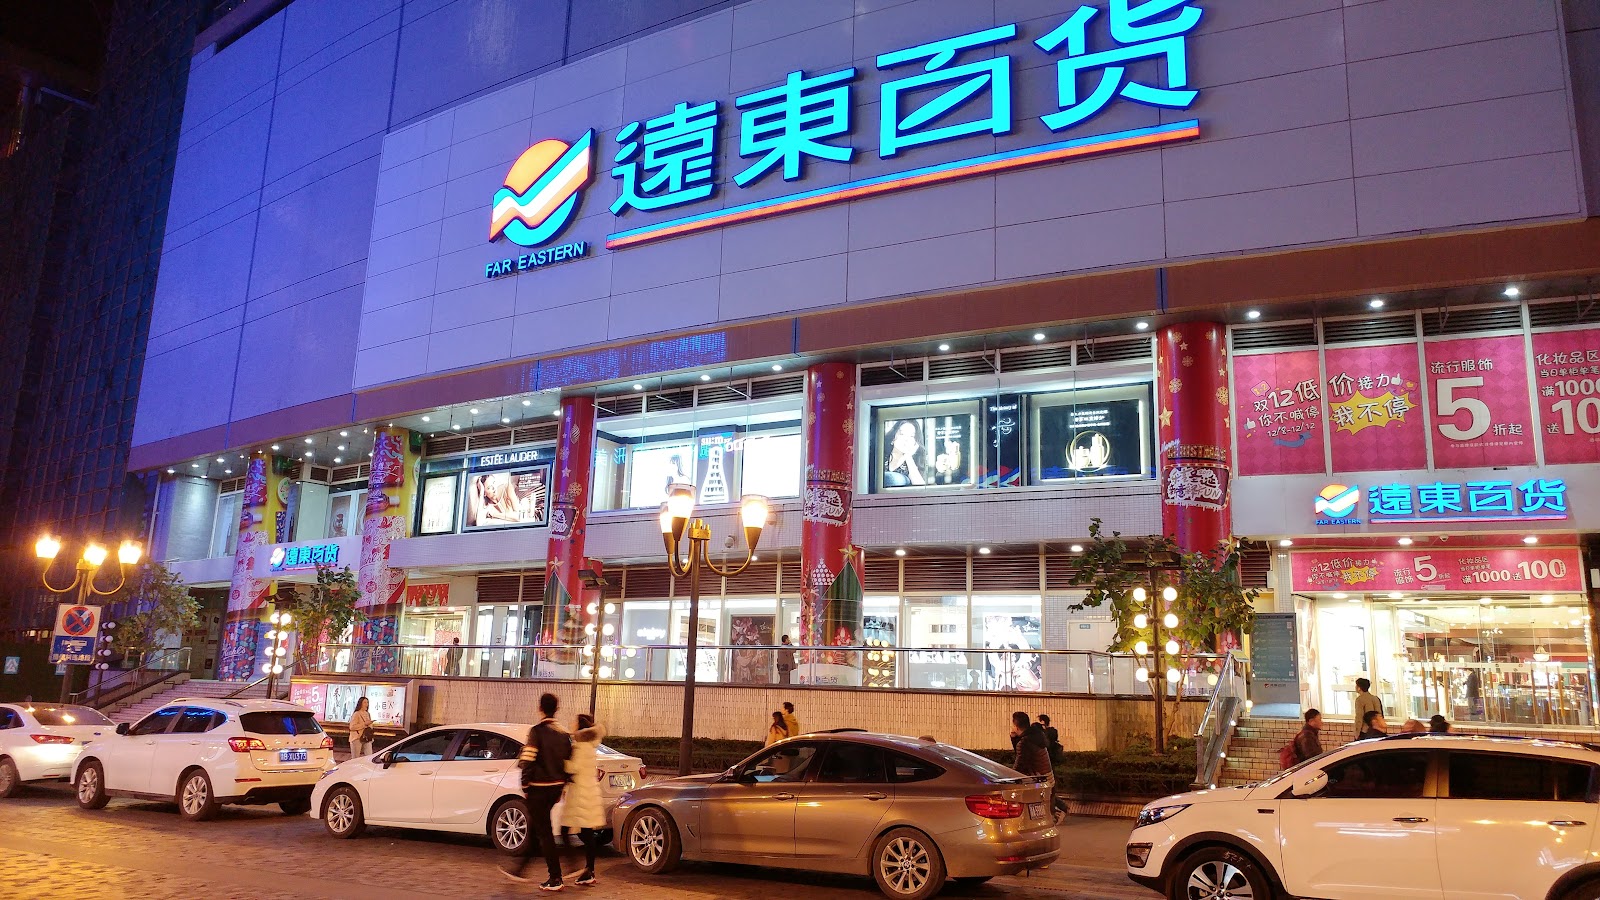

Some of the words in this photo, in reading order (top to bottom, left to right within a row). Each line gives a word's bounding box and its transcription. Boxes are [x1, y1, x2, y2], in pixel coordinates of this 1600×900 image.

[608, 0, 1203, 216] 遠東百货
[485, 259, 512, 278] FAR
[517, 241, 588, 271] EASTERN
[1431, 358, 1493, 374] 流行服饰
[1536, 350, 1600, 366] 化妆品区
[1334, 396, 1410, 427] 我不停
[1436, 376, 1491, 441] 5
[1493, 423, 1523, 436] 折起
[480, 453, 503, 466] ESTÉE
[504, 451, 539, 464] LAUDER
[1368, 479, 1568, 515] 遠東百货
[1331, 518, 1362, 526] EASTERN
[285, 544, 340, 566] 遠東百货
[1414, 555, 1437, 582] 5
